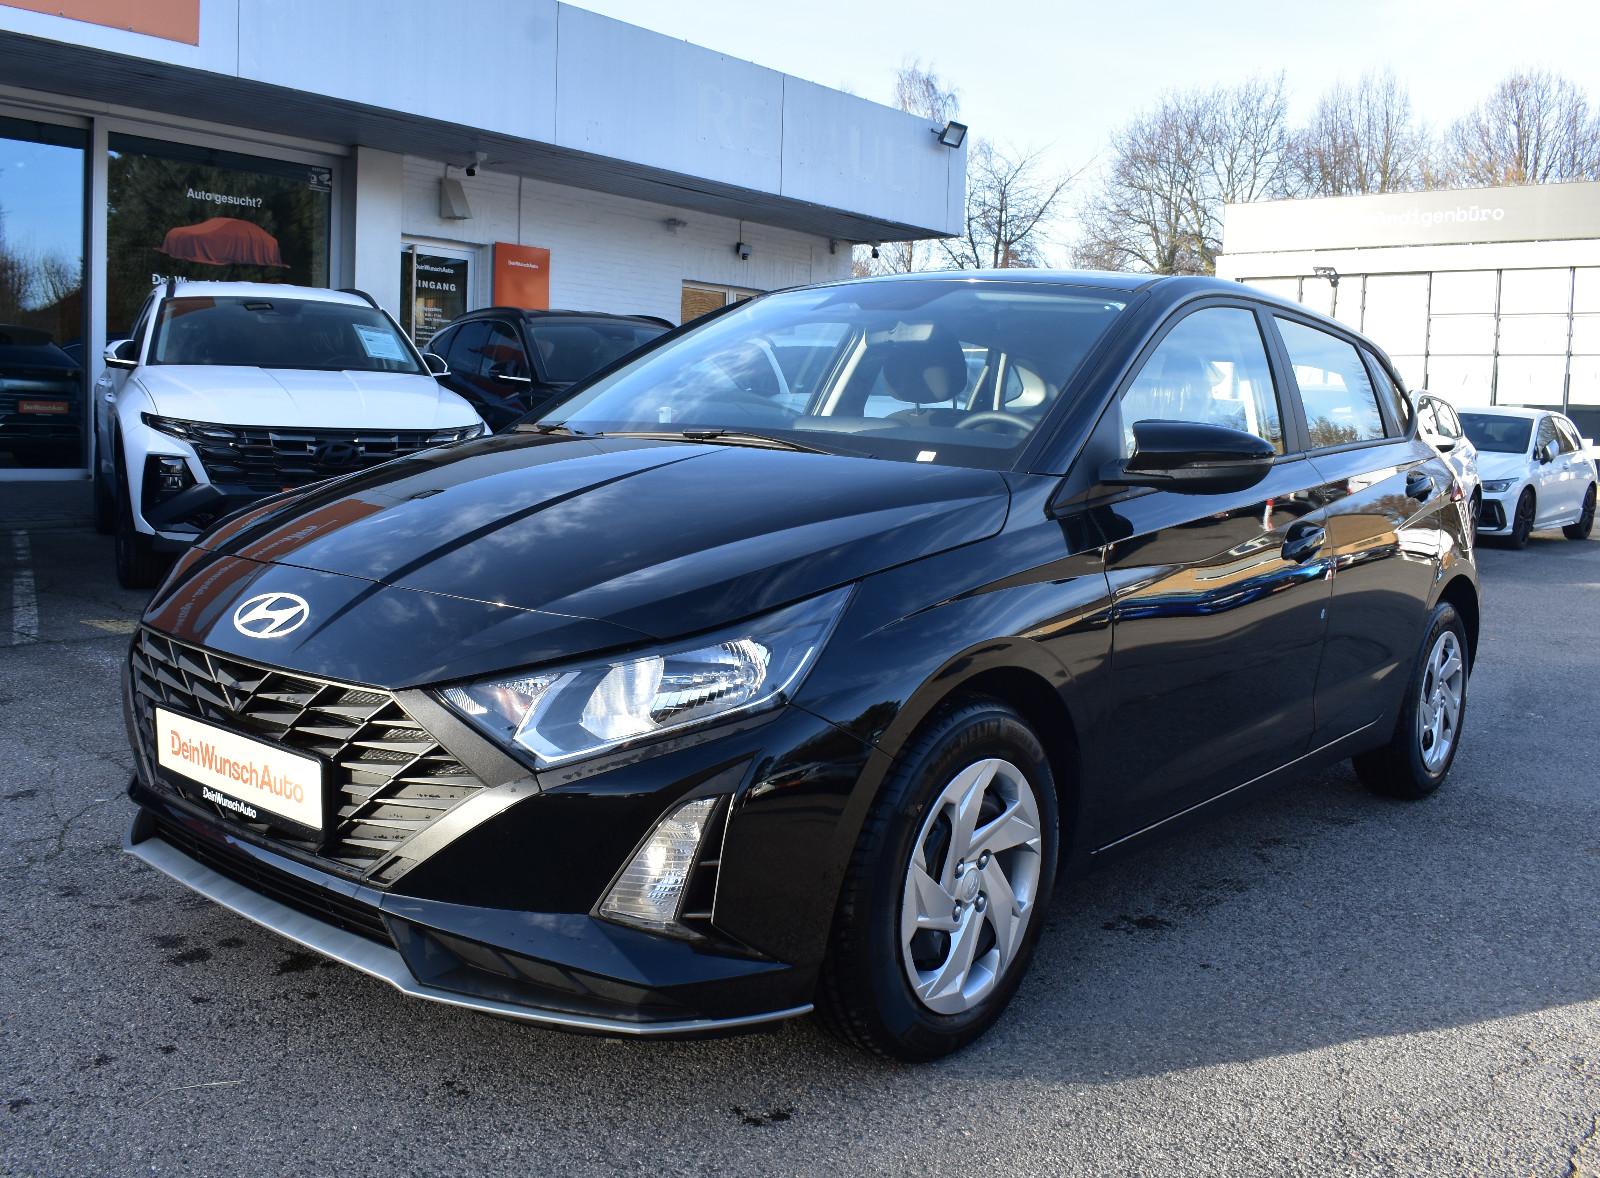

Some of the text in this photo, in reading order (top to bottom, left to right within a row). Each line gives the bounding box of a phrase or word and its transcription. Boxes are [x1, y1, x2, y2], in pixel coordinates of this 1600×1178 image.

[187, 188, 262, 208] Auto gesucht?
[415, 280, 457, 292] INGANG
[170, 729, 304, 804] DeinWunschAuto
[202, 786, 257, 819] DeinWunschAuto
